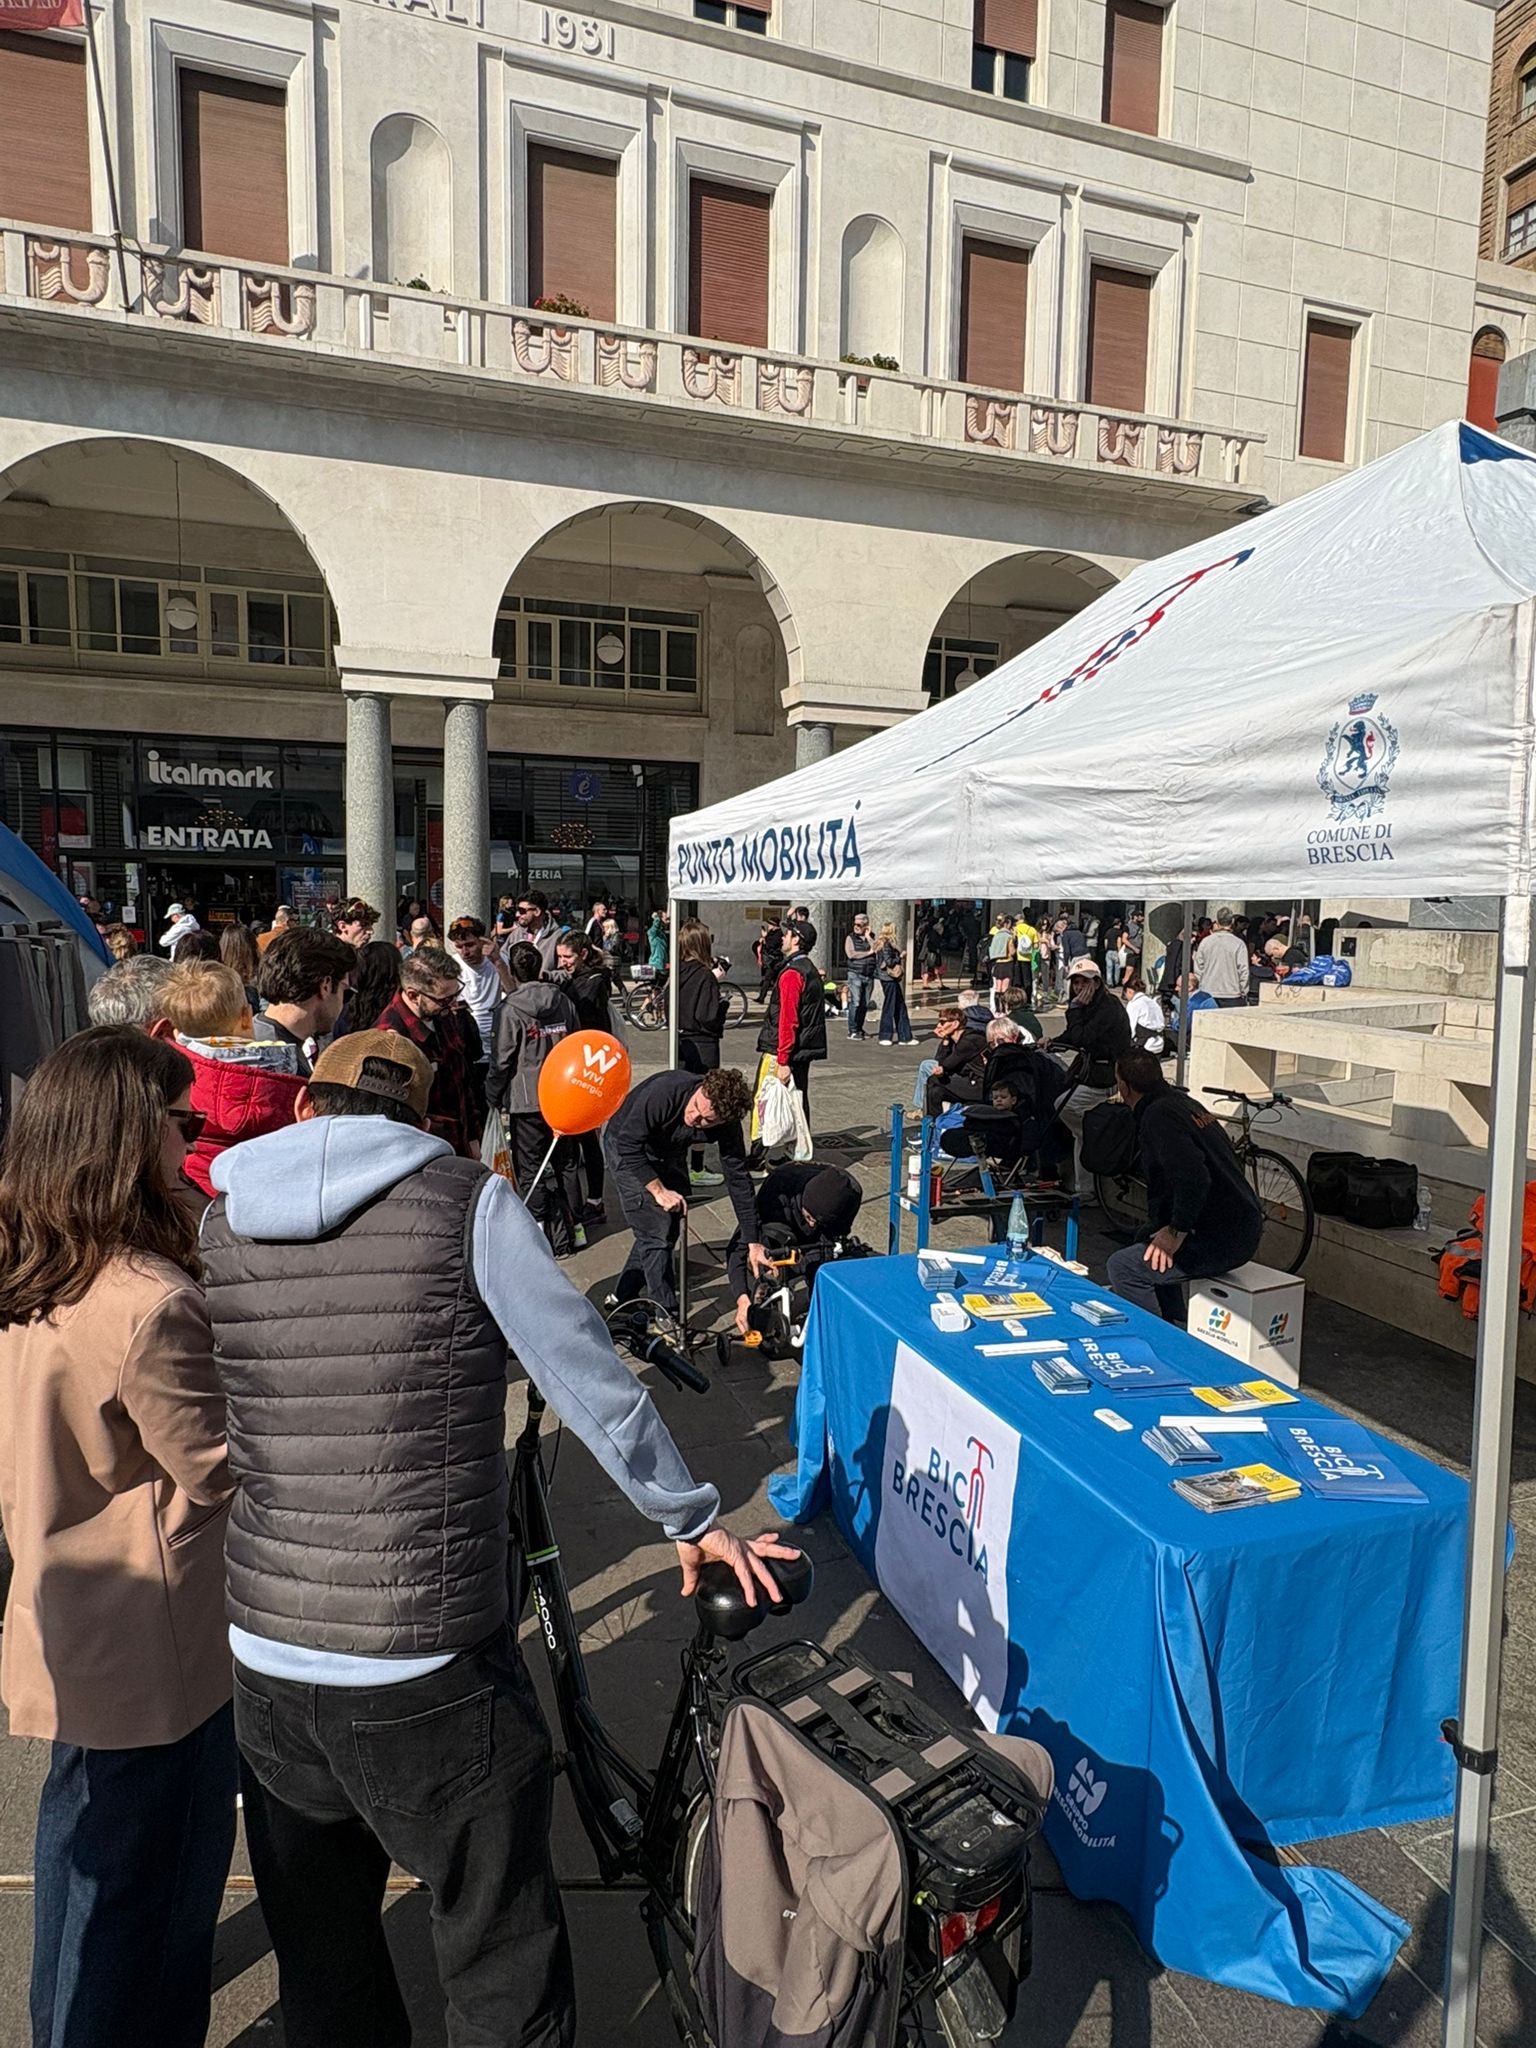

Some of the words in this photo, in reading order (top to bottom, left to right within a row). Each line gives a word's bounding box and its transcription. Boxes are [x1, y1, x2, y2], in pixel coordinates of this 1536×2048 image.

[540, 8, 615, 61] 1931
[147, 750, 274, 789] italmark
[147, 825, 273, 849] ENTRATA
[1306, 824, 1371, 845] COMUNE
[1375, 823, 1393, 839] DI
[677, 837, 737, 885] PUNTO
[1306, 842, 1395, 866] BRESCIA
[507, 868, 562, 880] PIZERIA
[1287, 1426, 1342, 1481] BRESCIA
[892, 1459, 990, 1587] BRESCIA
